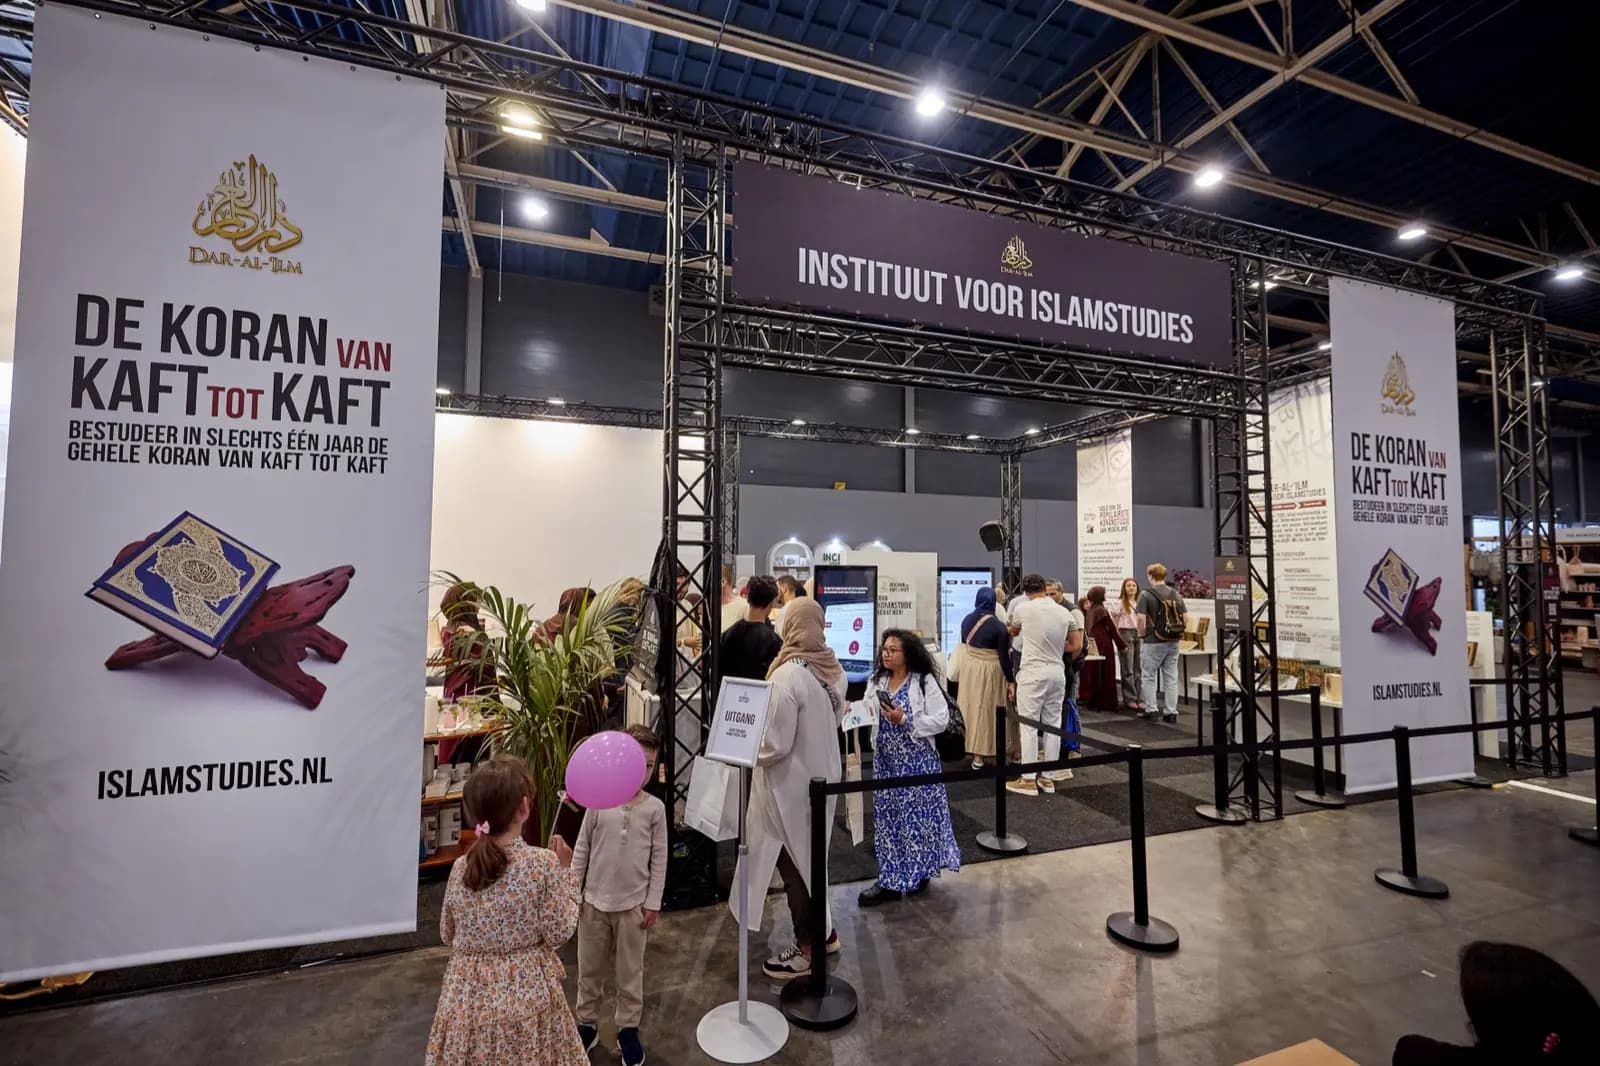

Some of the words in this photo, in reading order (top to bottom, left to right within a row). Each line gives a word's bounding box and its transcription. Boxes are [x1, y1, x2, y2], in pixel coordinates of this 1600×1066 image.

[798, 247, 948, 304] INSTITUUT
[954, 275, 1024, 318] VOOR
[1031, 288, 1194, 344] ISLAMSTUDIES
[74, 293, 144, 351] DE
[160, 302, 328, 366] KORAN
[337, 338, 392, 372] VAN
[70, 356, 208, 416] KAFT
[207, 385, 264, 420] TOT
[272, 372, 391, 427] KAFT
[69, 419, 177, 444] BESTUDEER
[183, 427, 201, 445] IN
[206, 427, 282, 450] SLECHTS
[287, 429, 319, 451] ÉÉN
[323, 433, 364, 454] JAAR
[368, 437, 389, 455] DE
[1351, 432, 1371, 462] DE
[1375, 434, 1426, 467] KORAN
[1428, 450, 1447, 469] VAN
[68, 442, 140, 464] GEHELE
[148, 446, 210, 466] KORAN
[218, 450, 253, 468] VAN
[261, 451, 303, 470] KAFT
[309, 453, 341, 472] TOT
[347, 455, 388, 475] KAFT
[1352, 465, 1391, 497] KAFT
[1391, 479, 1409, 498] TOT
[1410, 471, 1447, 501] KAFT
[1353, 499, 1384, 512] BESTUDEER
[1376, 512, 1395, 523] KORAN
[1396, 513, 1408, 524] VAN
[1409, 514, 1423, 525] KAFT
[1436, 516, 1448, 526] KAFT
[1373, 681, 1443, 701] ISLAMSTUDIES.NL
[725, 710, 756, 725] UITGANG
[98, 756, 333, 800] ISLAMSTUDIES.NL
